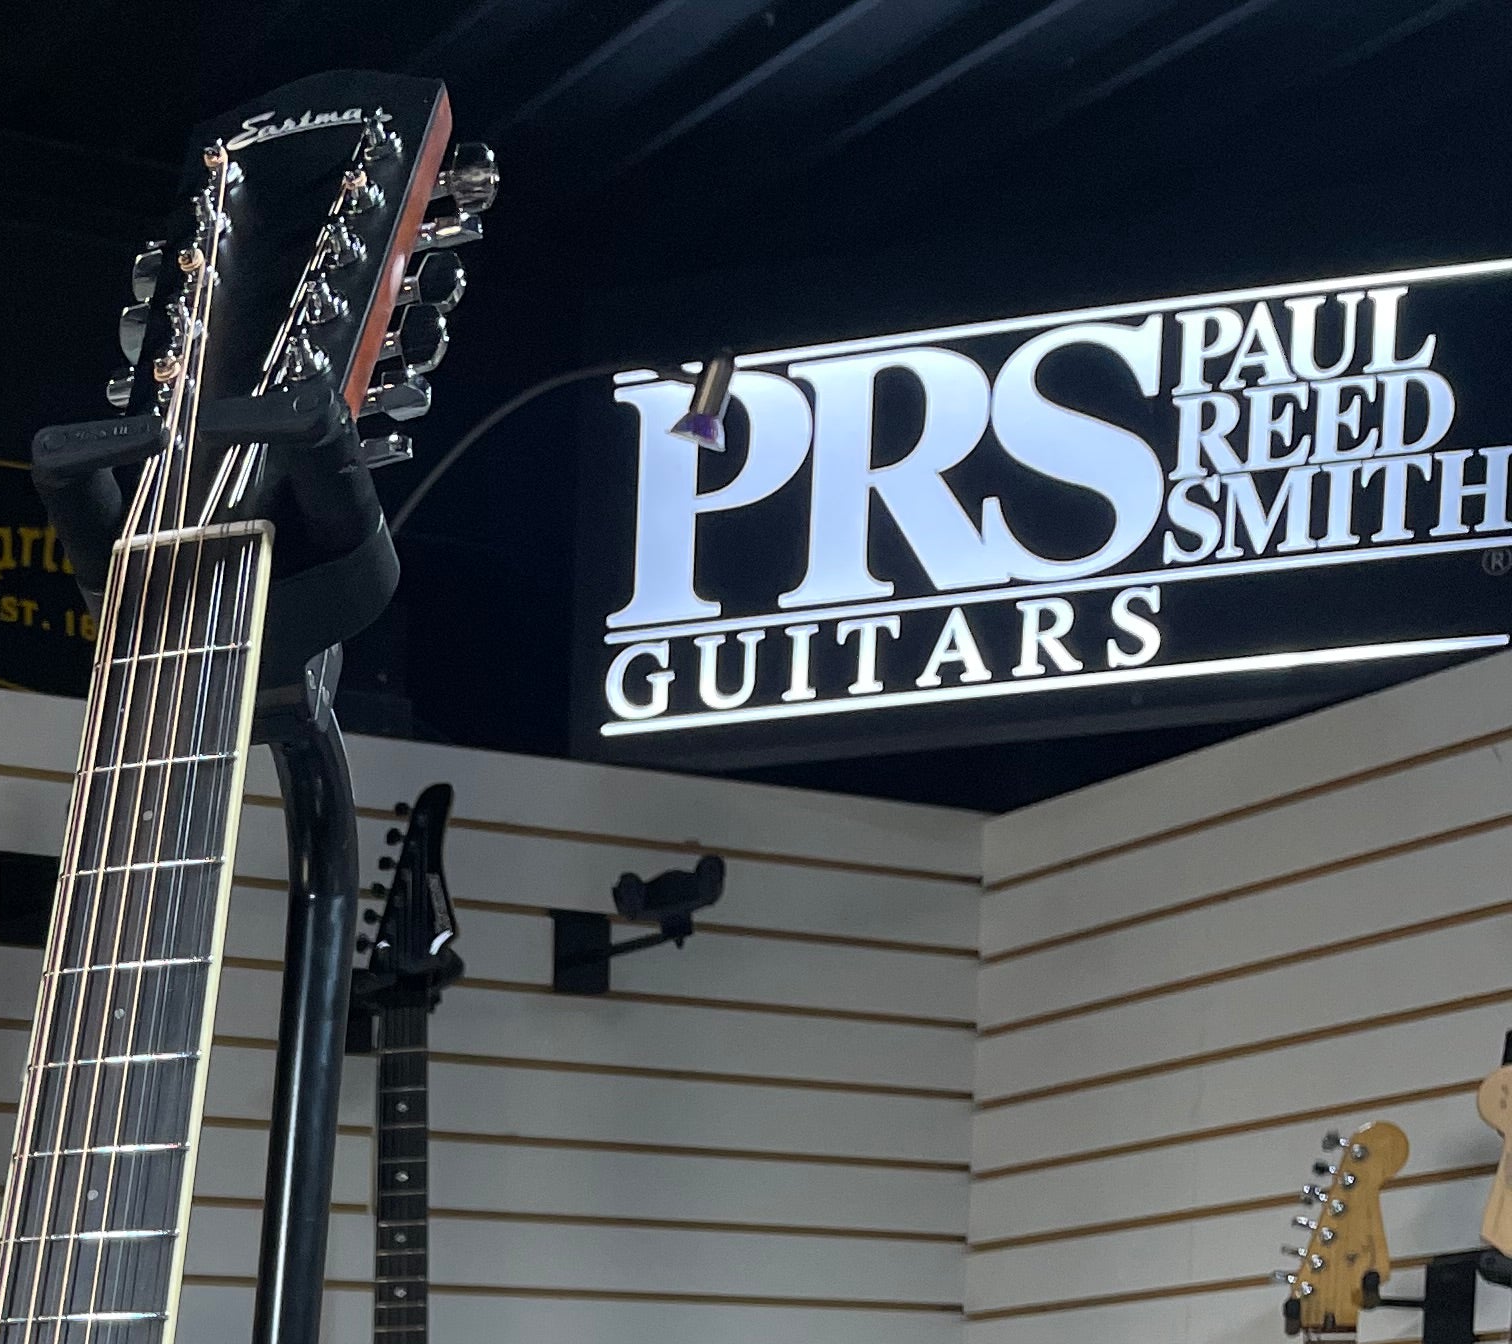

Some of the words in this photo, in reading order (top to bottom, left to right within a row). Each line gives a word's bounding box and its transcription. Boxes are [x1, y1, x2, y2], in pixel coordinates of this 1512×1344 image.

[1173, 286, 1437, 398] PAUL
[605, 315, 1165, 630] PRS
[1170, 367, 1456, 482] REED
[1163, 446, 1512, 565] SMITH
[605, 586, 1164, 721] GUITARS
